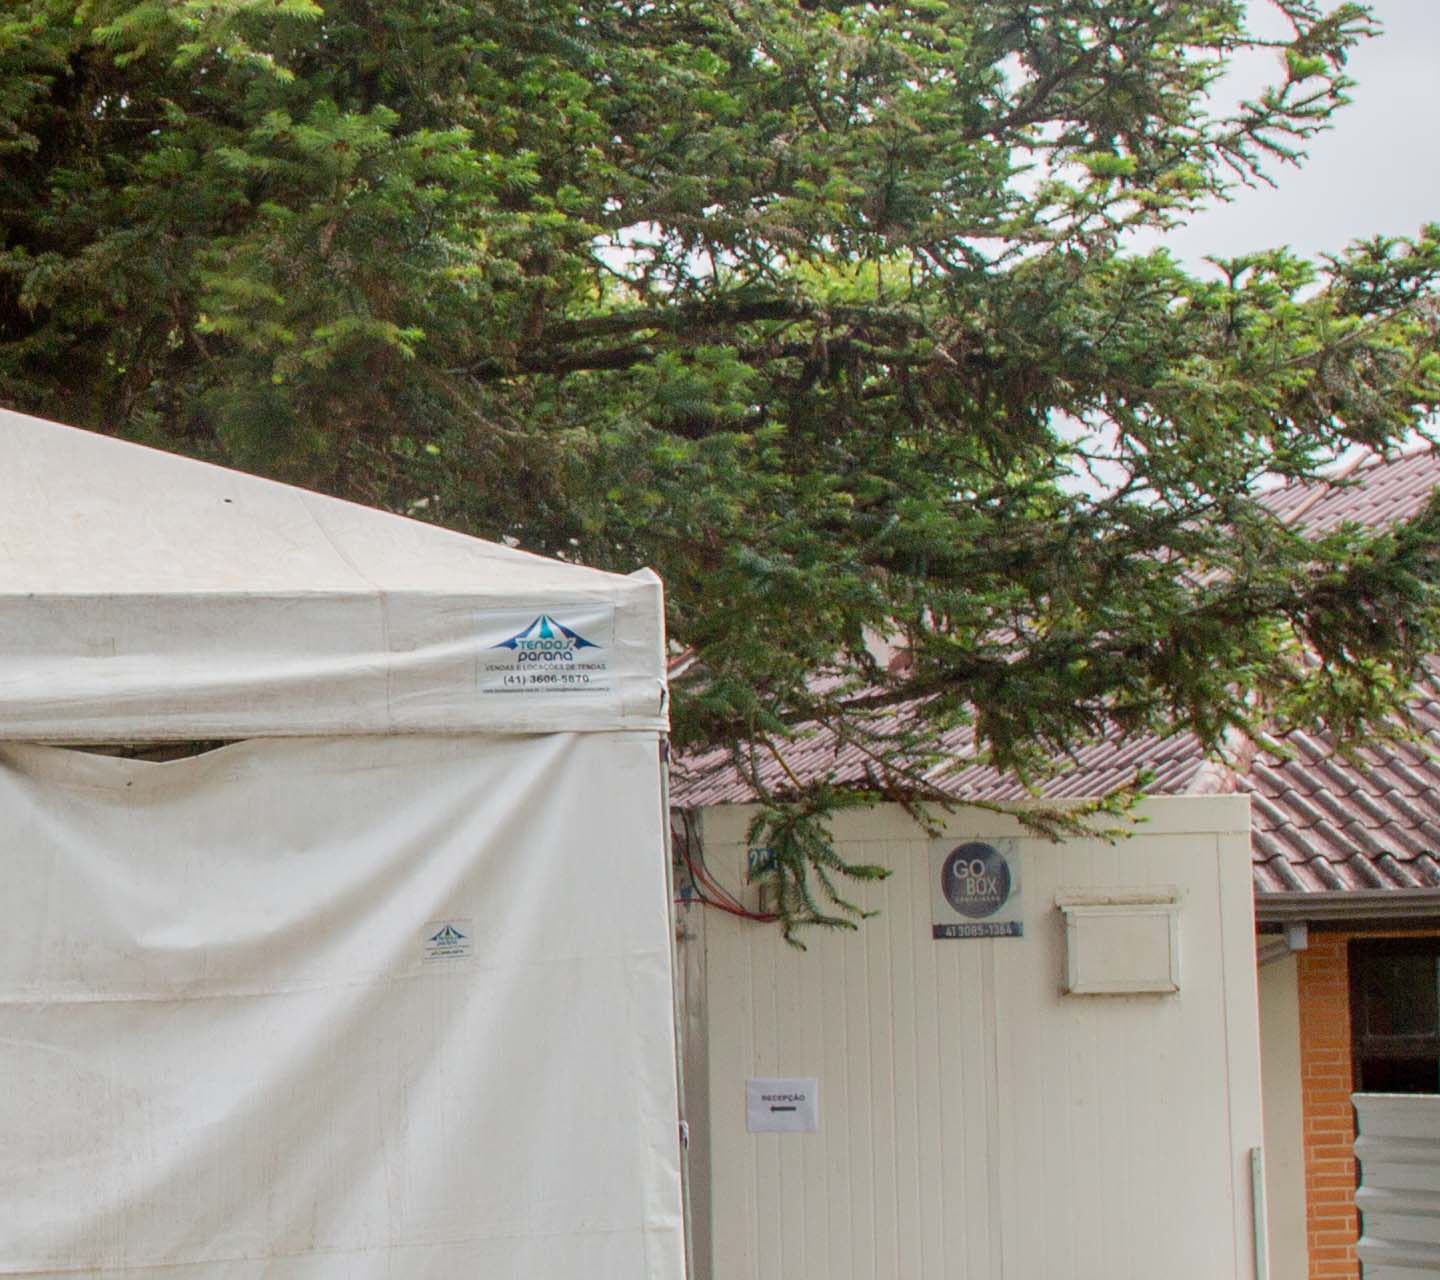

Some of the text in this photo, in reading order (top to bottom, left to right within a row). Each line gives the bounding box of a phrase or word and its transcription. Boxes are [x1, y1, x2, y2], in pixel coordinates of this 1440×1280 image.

[504, 675, 526, 685] (41)
[953, 859, 986, 879] GO
[966, 878, 998, 895] BOX
